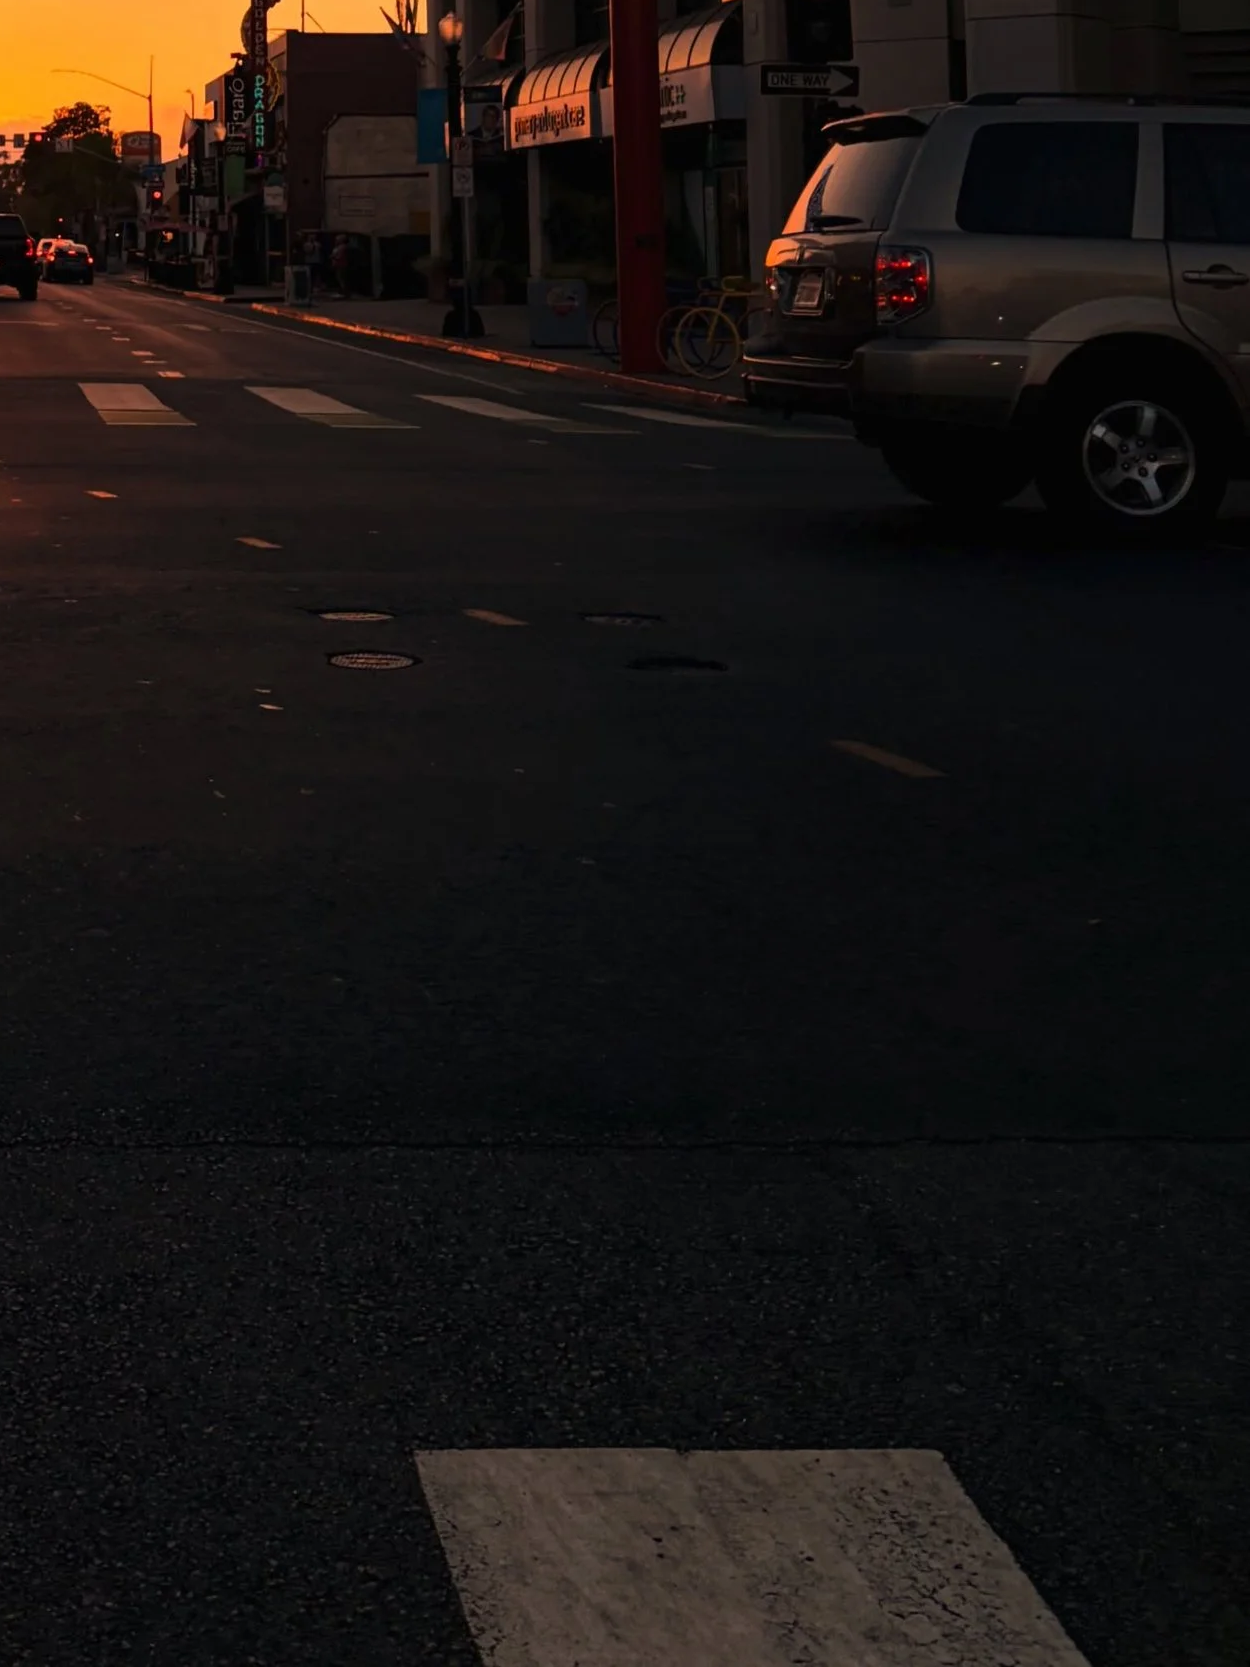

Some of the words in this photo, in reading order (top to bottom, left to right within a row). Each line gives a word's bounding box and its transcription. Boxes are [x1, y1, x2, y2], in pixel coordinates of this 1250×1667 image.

[771, 74, 798, 86] ONE
[803, 74, 829, 86] WAY
[254, 74, 265, 148] DRAGON
